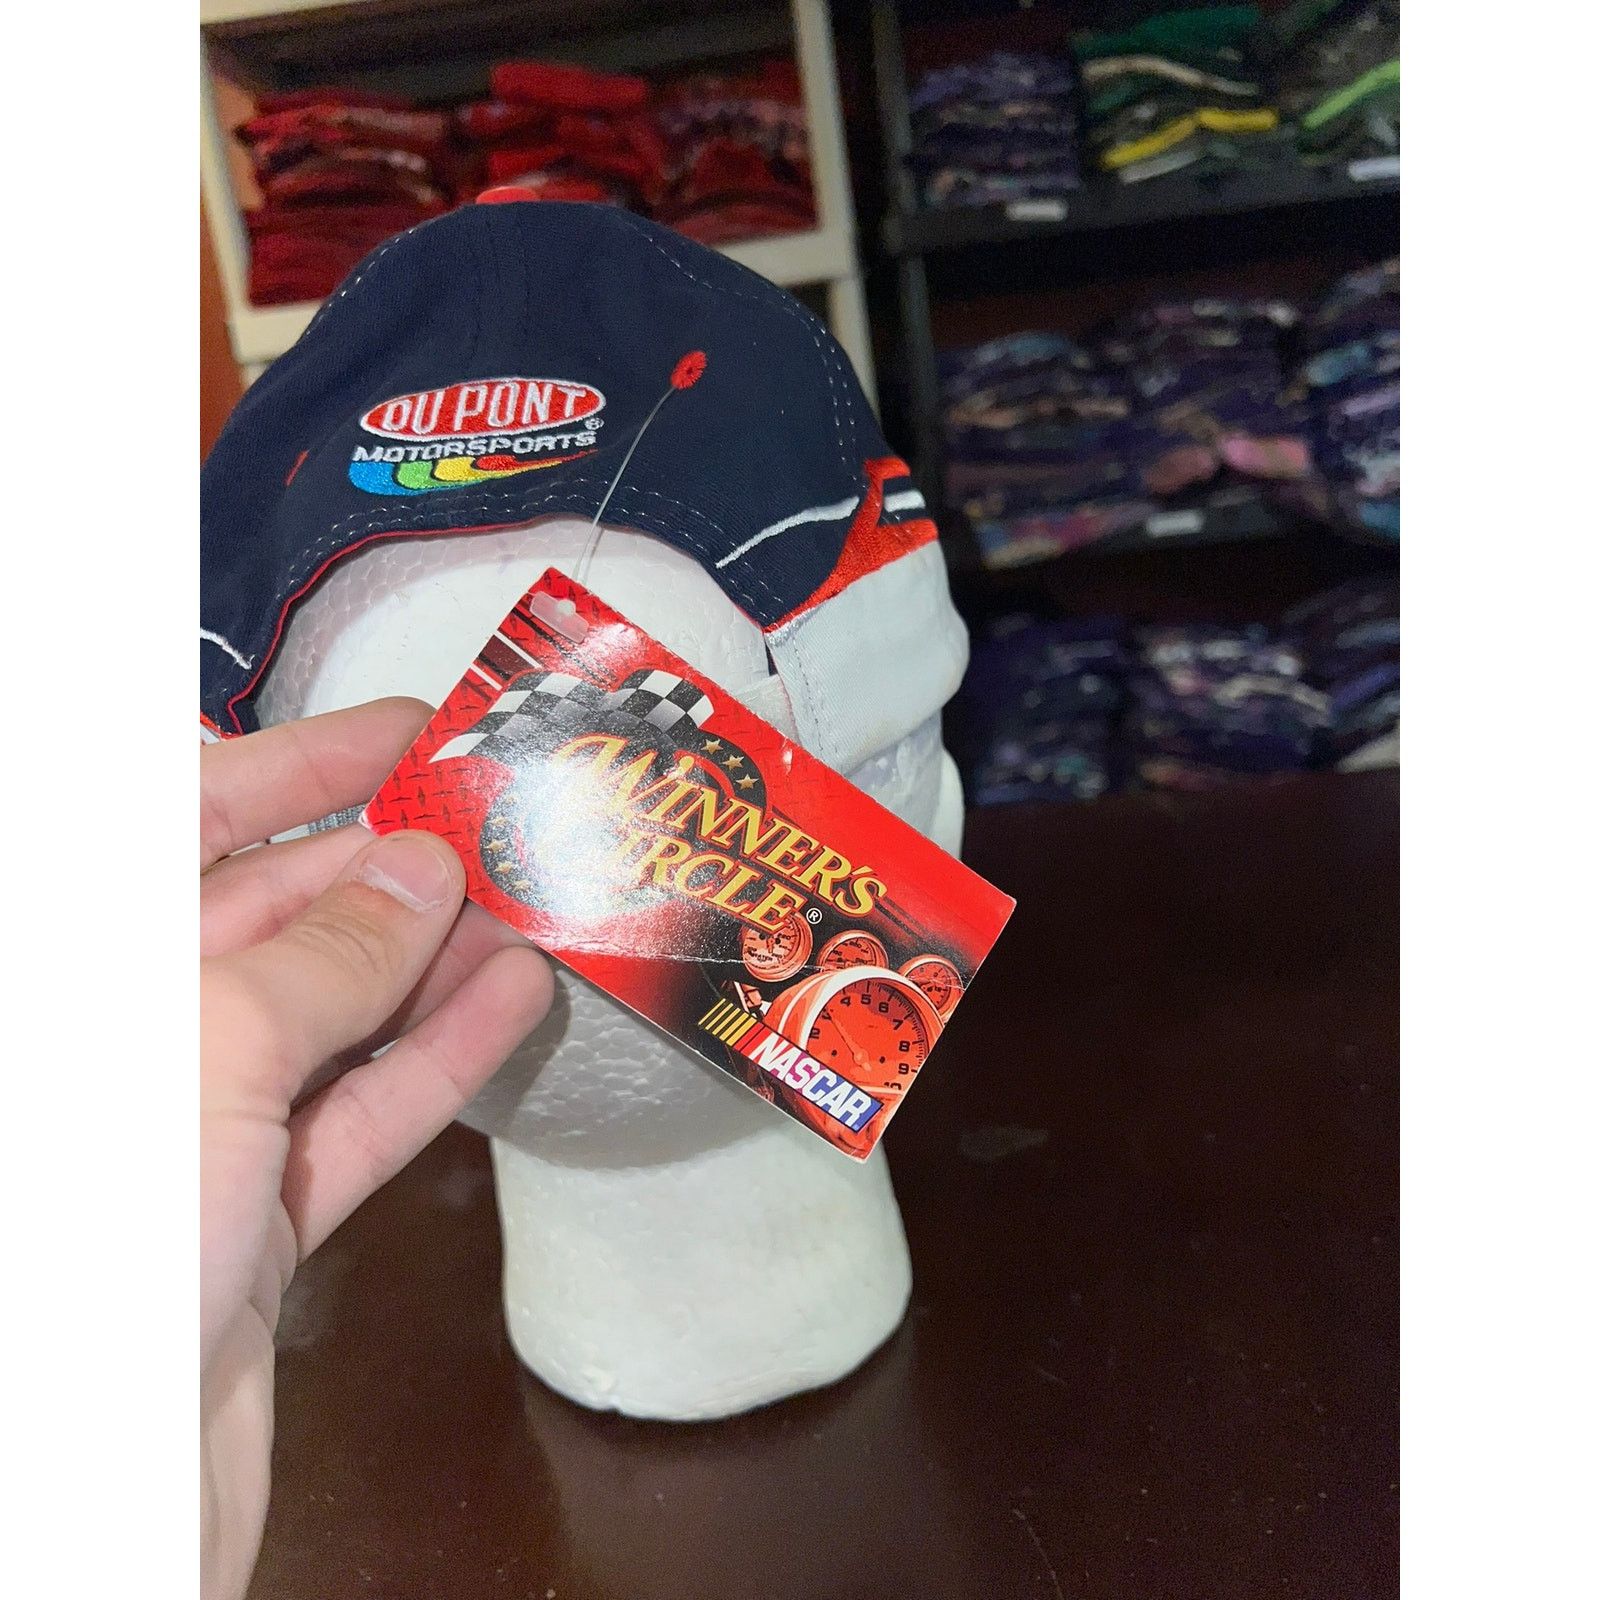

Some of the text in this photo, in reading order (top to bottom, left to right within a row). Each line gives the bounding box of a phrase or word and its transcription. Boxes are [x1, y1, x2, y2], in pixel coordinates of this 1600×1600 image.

[379, 381, 588, 435] DU PONT
[352, 430, 598, 462] MOTORSPORTS
[537, 820, 808, 934] IRCLE
[840, 996, 851, 1007] 4
[861, 993, 872, 1005] 5
[878, 1001, 889, 1013] 6
[892, 1019, 904, 1030] 7
[898, 1040, 911, 1052] 8
[898, 1063, 909, 1075] 9
[748, 1034, 872, 1127] NASCAR
